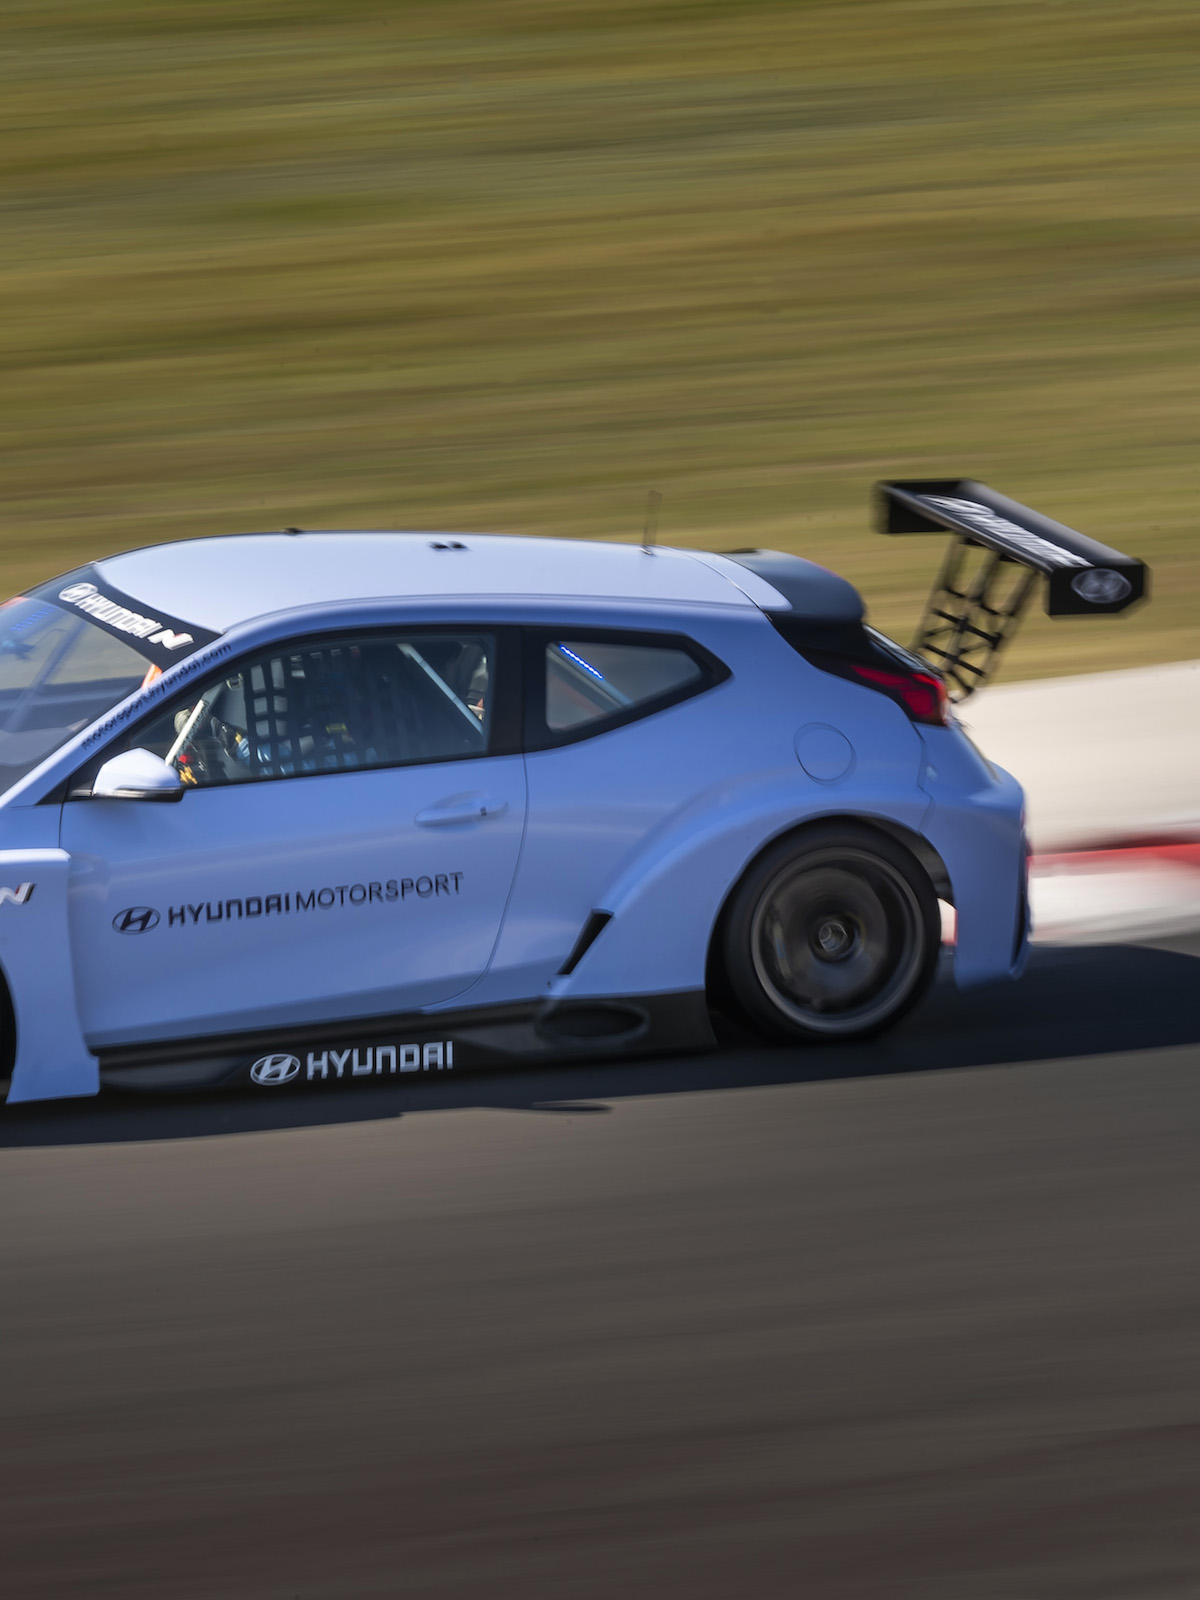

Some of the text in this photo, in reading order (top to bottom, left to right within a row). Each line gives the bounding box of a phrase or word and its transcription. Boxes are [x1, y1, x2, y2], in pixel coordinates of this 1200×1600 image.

[74, 592, 163, 639] HYUNDAI
[168, 871, 464, 928] HYUNDAI MOTORSPORT
[306, 1040, 454, 1081] HYUNDAI
